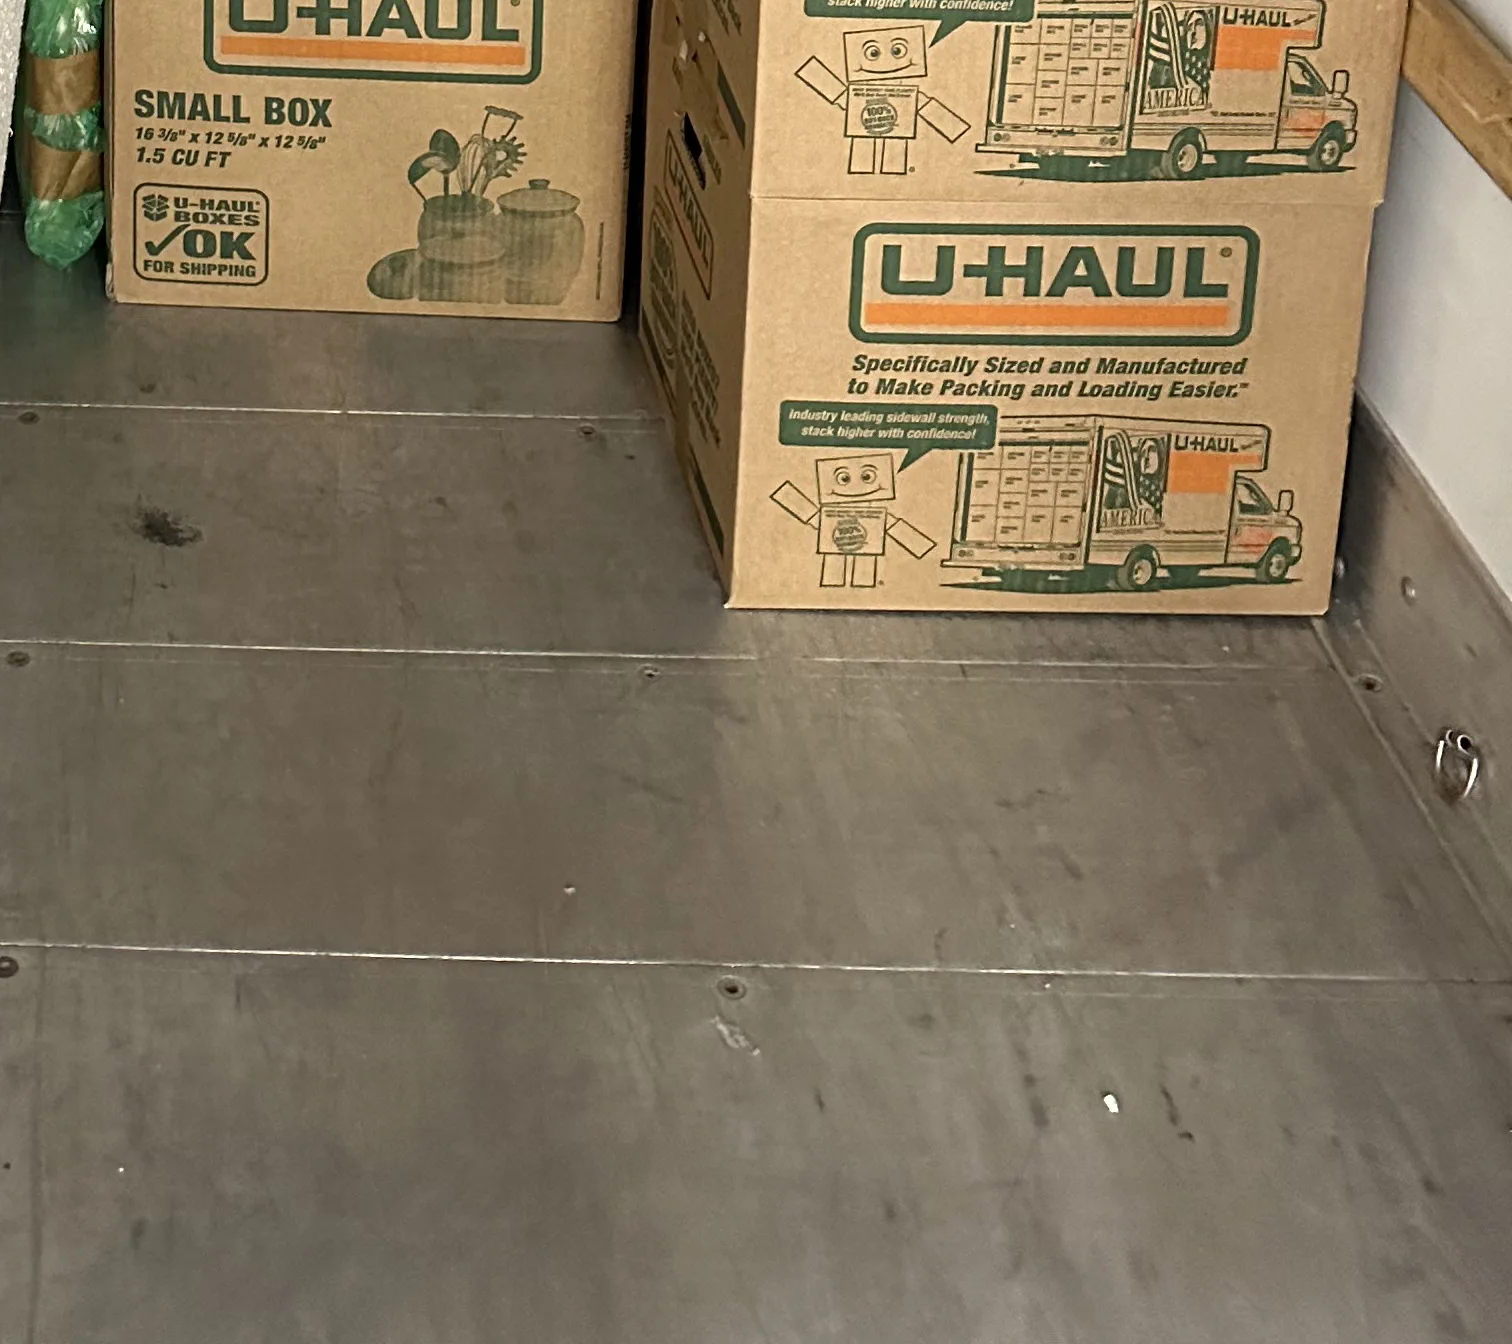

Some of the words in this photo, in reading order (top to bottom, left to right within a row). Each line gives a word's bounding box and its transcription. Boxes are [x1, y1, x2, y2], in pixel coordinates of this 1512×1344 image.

[1222, 7, 1291, 27] U-HAUL
[134, 89, 251, 124] SMALL
[264, 96, 333, 128] BOX
[1144, 86, 1207, 110] AMERICA
[135, 127, 154, 140] 16
[157, 127, 186, 142] 3/8"
[188, 132, 200, 144] x
[204, 131, 224, 145] 12
[227, 131, 256, 146] 5/8"
[258, 136, 269, 148] x
[275, 134, 294, 149] 12
[297, 135, 327, 150] 5/8"
[136, 147, 166, 164] 1.5
[171, 148, 200, 166] CU
[204, 150, 232, 168] FT
[174, 210, 261, 227] BOXES
[182, 228, 257, 261] OK
[143, 259, 175, 273] FOR
[179, 261, 256, 278] SHIPPING
[851, 354, 979, 376] Specifically
[984, 356, 1044, 375] Sized
[1047, 356, 1090, 375] and
[1095, 357, 1248, 376] Manufactured
[847, 378, 868, 395] to
[875, 378, 934, 396] Make
[939, 378, 1025, 401] Packing
[1031, 380, 1073, 399] and
[1077, 380, 1163, 402] Loading
[788, 408, 839, 423] Industry
[840, 409, 884, 424] leading
[886, 410, 936, 424] sidewall
[937, 412, 991, 427] strength,
[800, 425, 834, 437] stack
[837, 426, 876, 440] higher
[877, 427, 904, 439] with
[906, 427, 977, 440] confidence!
[1174, 434, 1239, 452] U-HAUL
